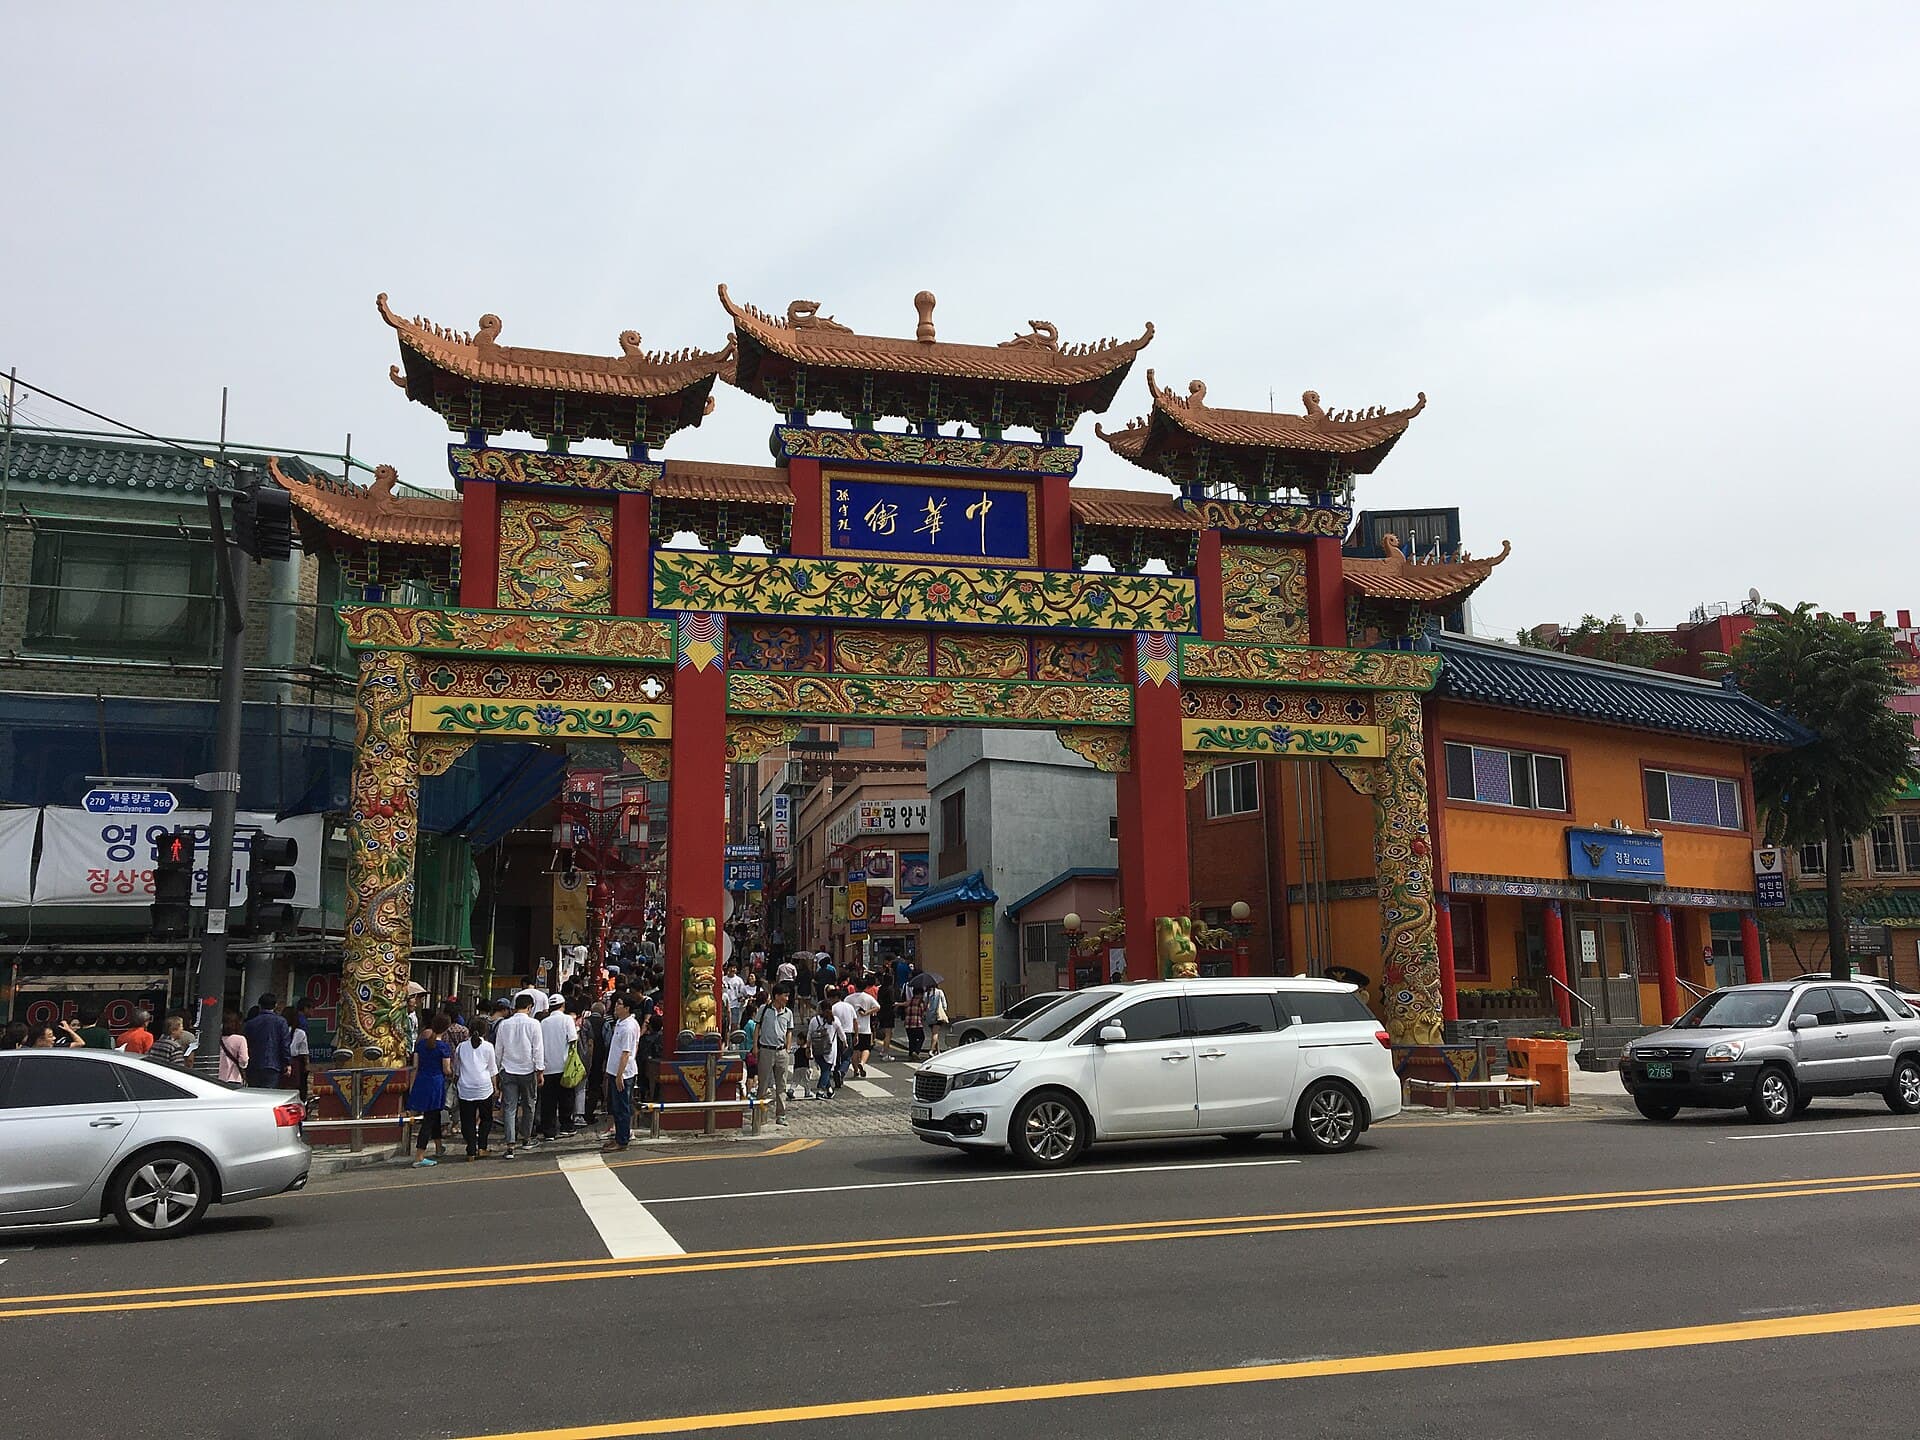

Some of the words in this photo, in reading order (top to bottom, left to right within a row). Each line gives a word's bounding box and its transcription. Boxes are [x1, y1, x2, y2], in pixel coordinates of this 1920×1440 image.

[863, 491, 993, 554] 中華街
[89, 797, 106, 806] 270
[109, 793, 151, 804] 제물량로
[153, 799, 171, 808] 266
[1615, 852, 1631, 865] 경찰
[1633, 857, 1652, 866] POLICE
[1648, 1068, 1672, 1078] 2785
